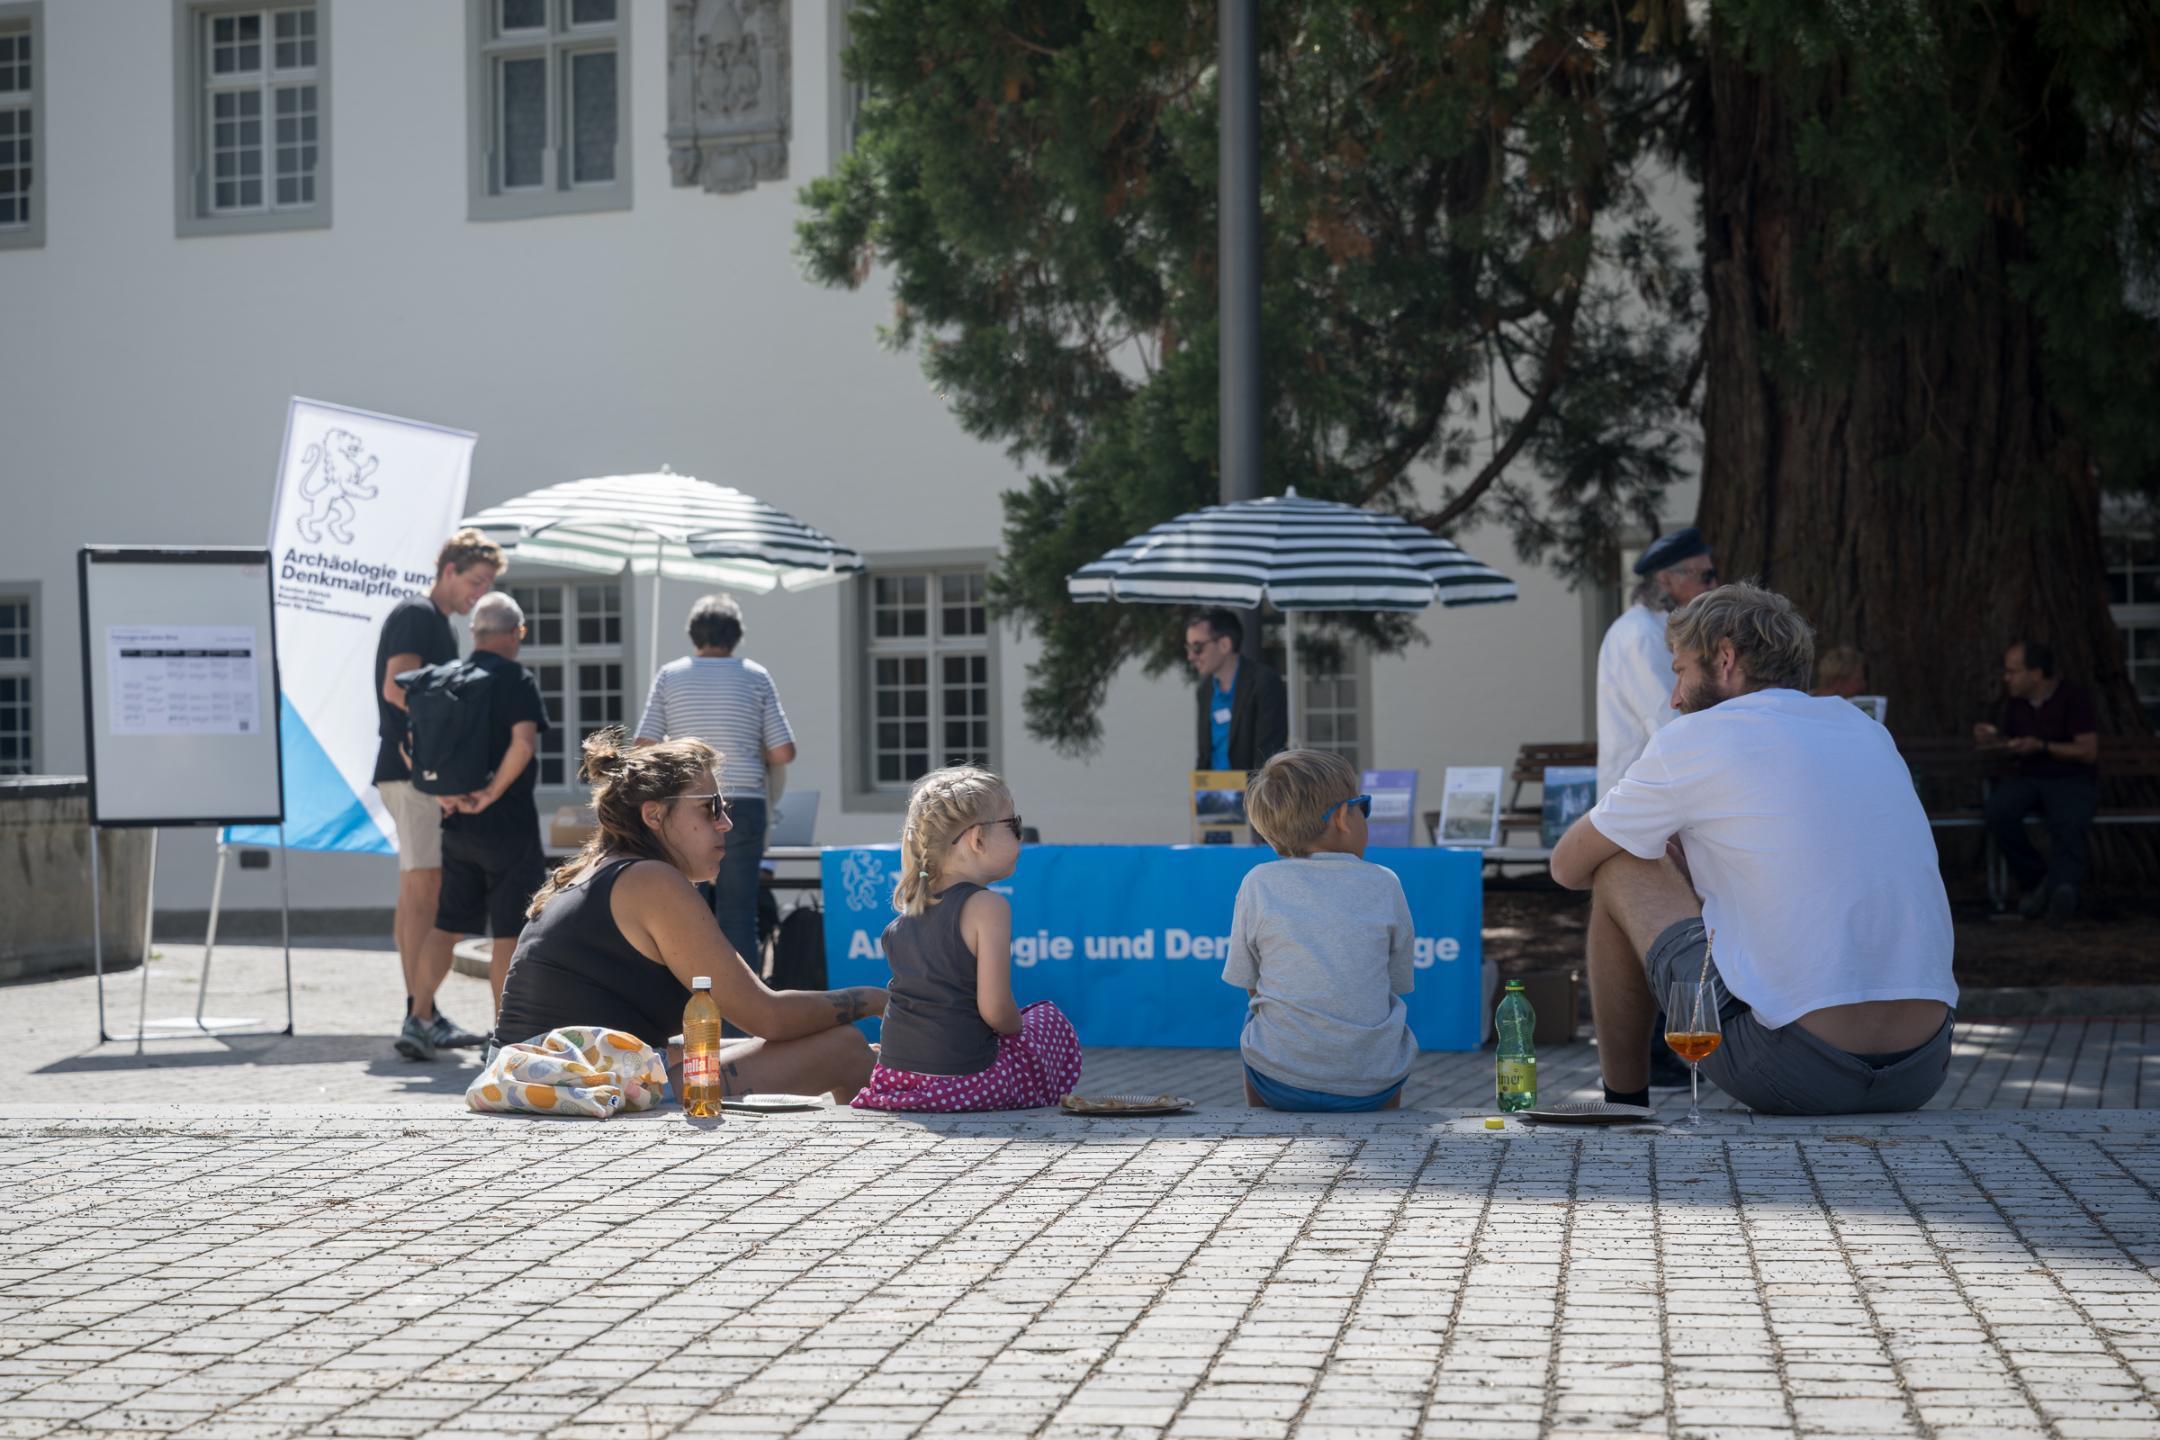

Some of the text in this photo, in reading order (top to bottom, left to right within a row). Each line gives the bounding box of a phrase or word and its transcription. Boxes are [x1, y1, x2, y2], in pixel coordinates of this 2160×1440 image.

[284, 548, 398, 580] Archäologie
[281, 564, 421, 600] Denkmalpfleg
[1084, 928, 1155, 960] und
